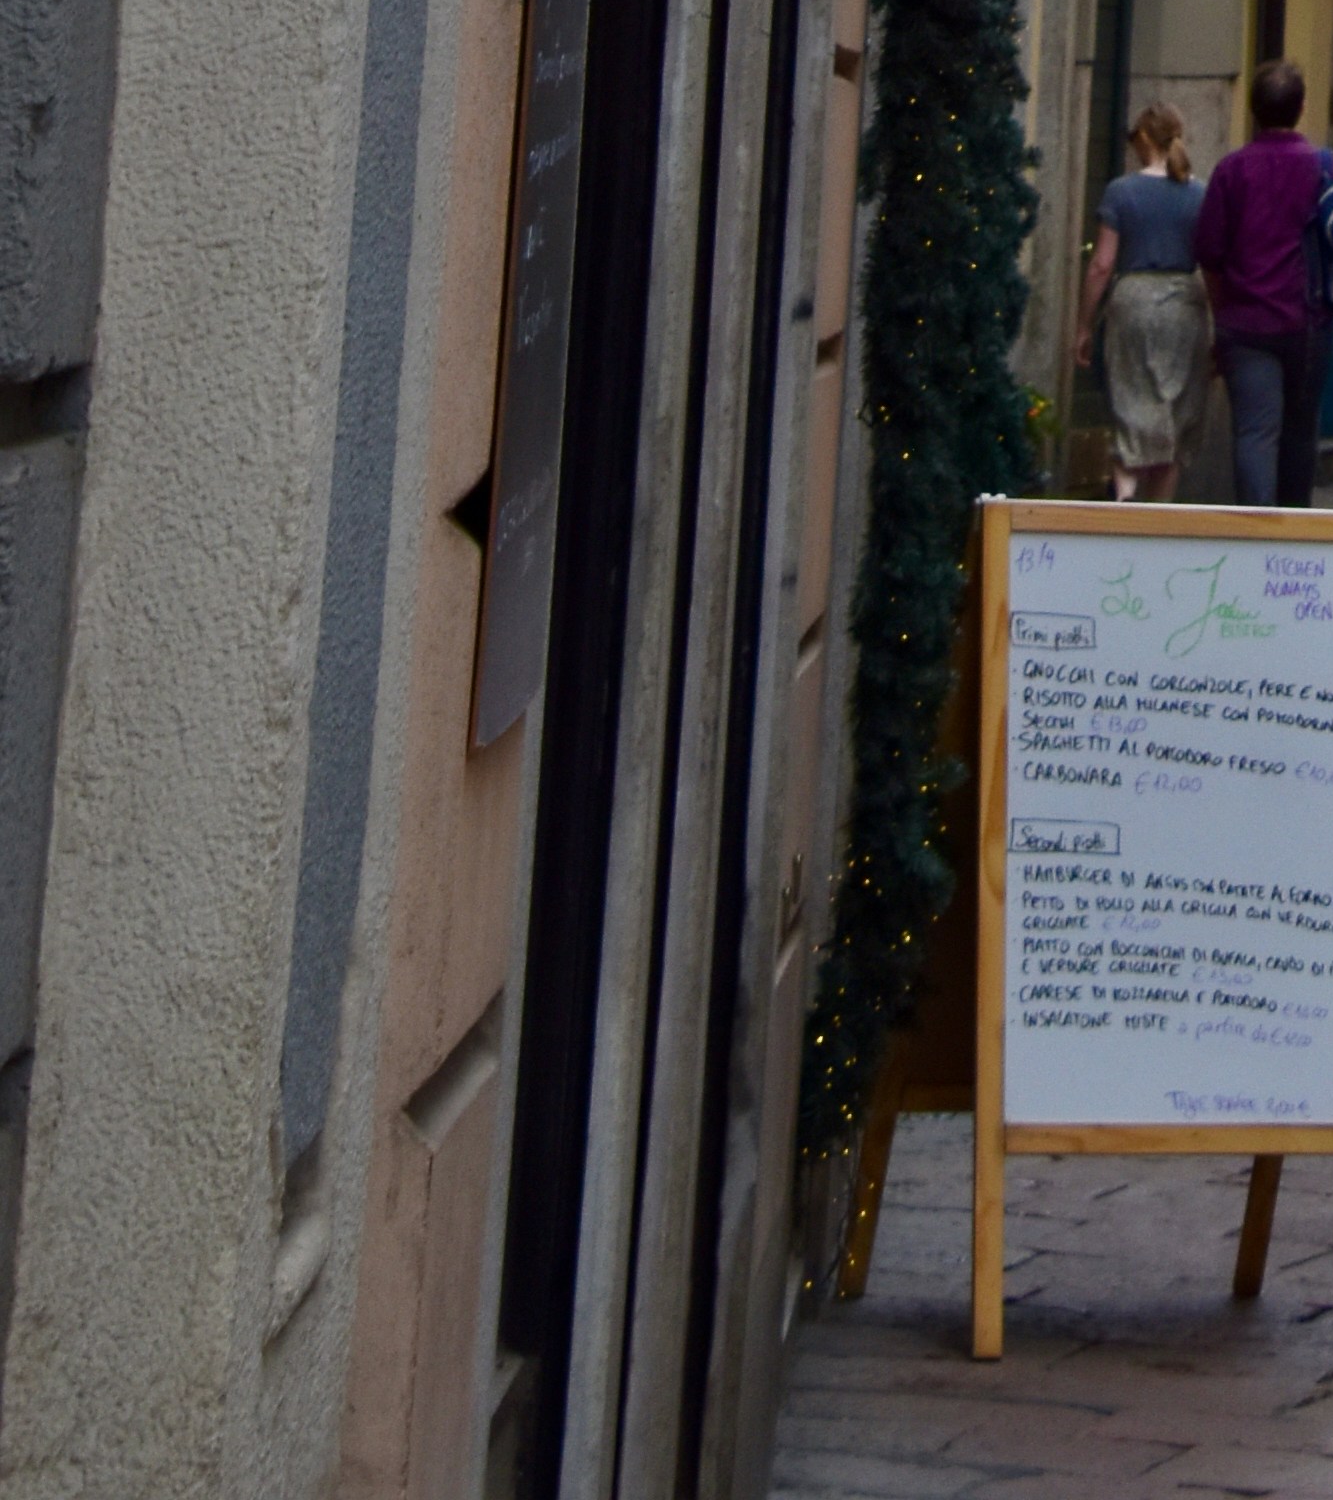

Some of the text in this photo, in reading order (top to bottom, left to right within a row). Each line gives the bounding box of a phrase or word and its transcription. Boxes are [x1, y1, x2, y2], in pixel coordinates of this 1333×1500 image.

[1265, 554, 1325, 577] KITCHEN
[1264, 580, 1320, 599] ALWAYS
[1023, 659, 1095, 684] GNOCCHI
[1105, 670, 1139, 687] CON
[1258, 678, 1295, 698] PERE
[1300, 685, 1312, 700] E
[1023, 686, 1087, 709] RISOTTO
[1093, 694, 1127, 710] ALLA
[1136, 698, 1215, 718] MILANESE
[1221, 705, 1249, 722] CON
[1018, 731, 1111, 751] SPAGHETTI
[1118, 739, 1139, 757] AL
[1023, 761, 1122, 787] CARBONARA
[1023, 864, 1112, 885] HAMBURGER
[1022, 890, 1065, 911] PETTO
[1095, 896, 1135, 912] POLLO
[1141, 899, 1174, 913] ALLA
[1245, 906, 1271, 921] CON
[1077, 940, 1104, 957] CON
[1109, 960, 1180, 977] GRIGLIATE
[1019, 983, 1082, 1003] CAPRESE
